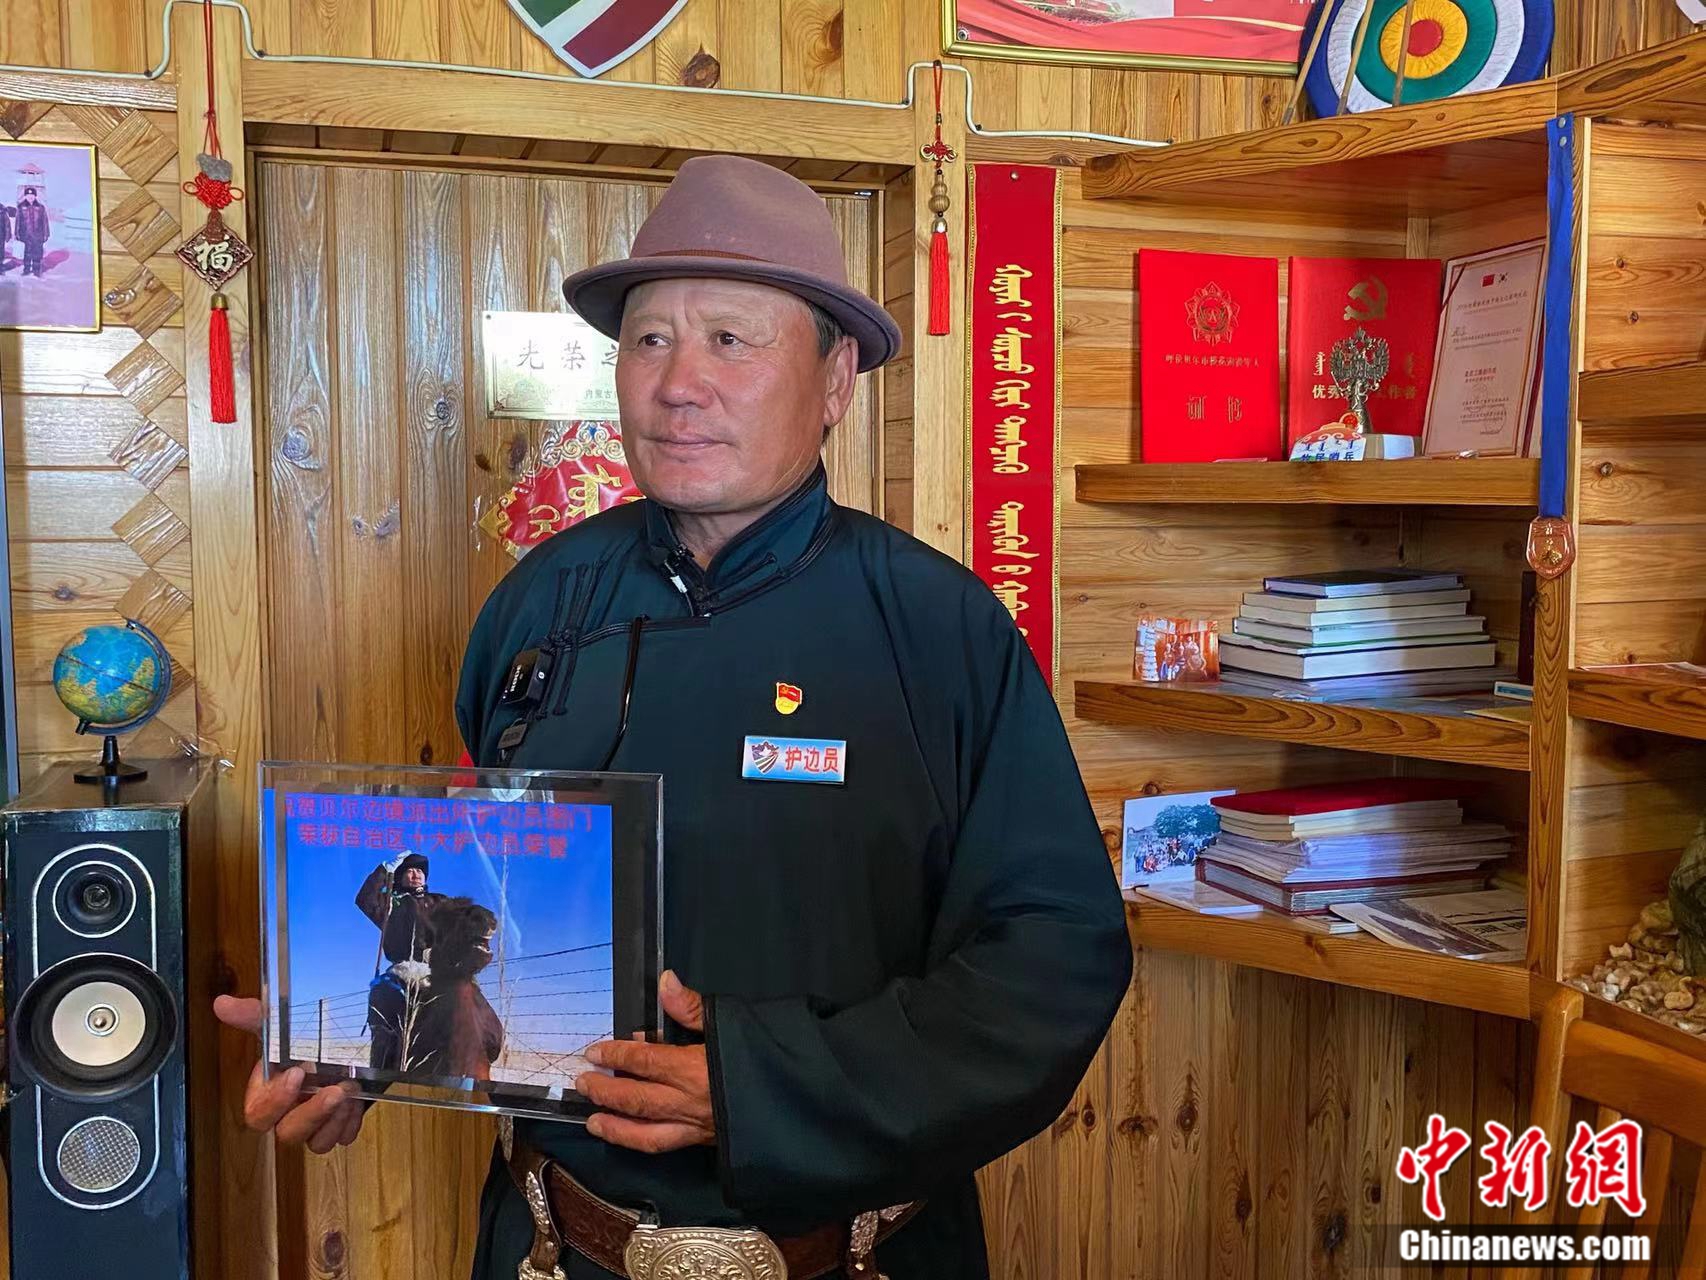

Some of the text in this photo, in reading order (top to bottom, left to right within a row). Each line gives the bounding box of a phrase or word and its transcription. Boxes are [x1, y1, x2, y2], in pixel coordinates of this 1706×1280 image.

[194, 234, 234, 273] 福
[584, 388, 618, 400] 内蒙古
[784, 745, 840, 774] 护边员
